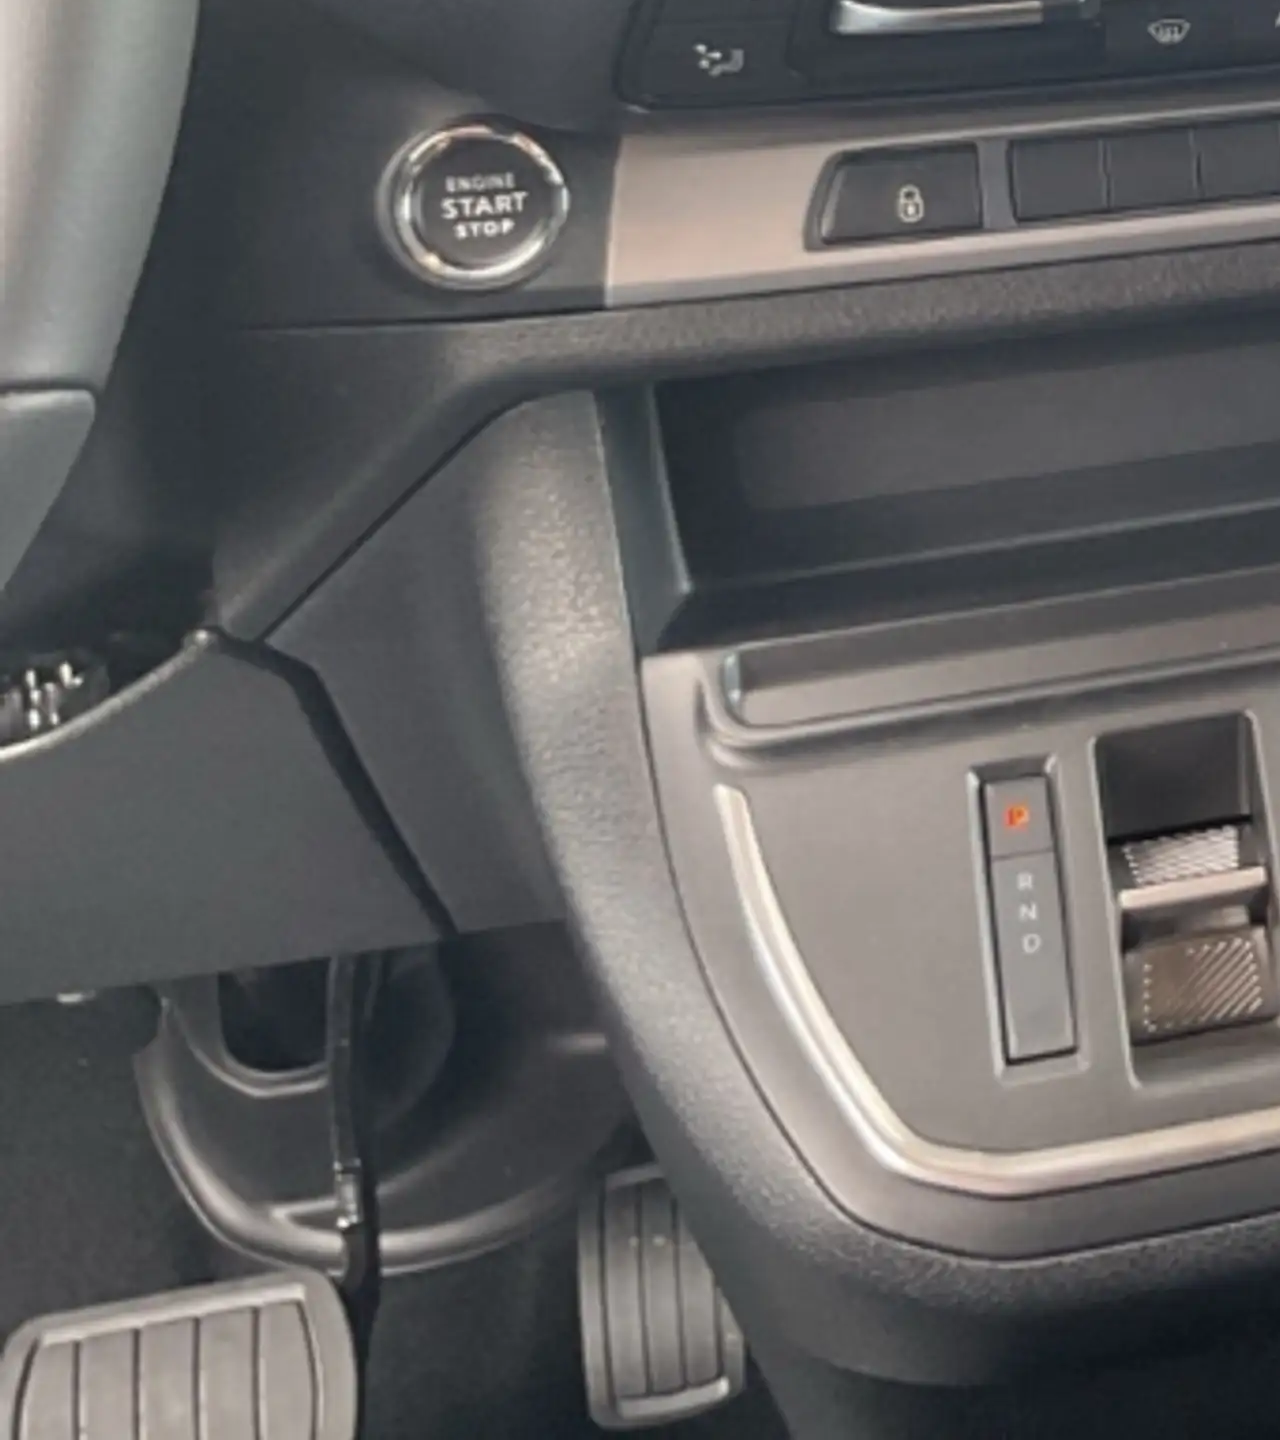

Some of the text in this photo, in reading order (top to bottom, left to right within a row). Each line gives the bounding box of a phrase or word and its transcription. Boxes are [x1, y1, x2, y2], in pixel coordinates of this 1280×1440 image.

[445, 172, 516, 192] ENGINE
[440, 190, 529, 220] START
[454, 218, 515, 240] STOP
[1004, 806, 1030, 827] P
[1016, 872, 1034, 891] R
[1019, 901, 1038, 922] N
